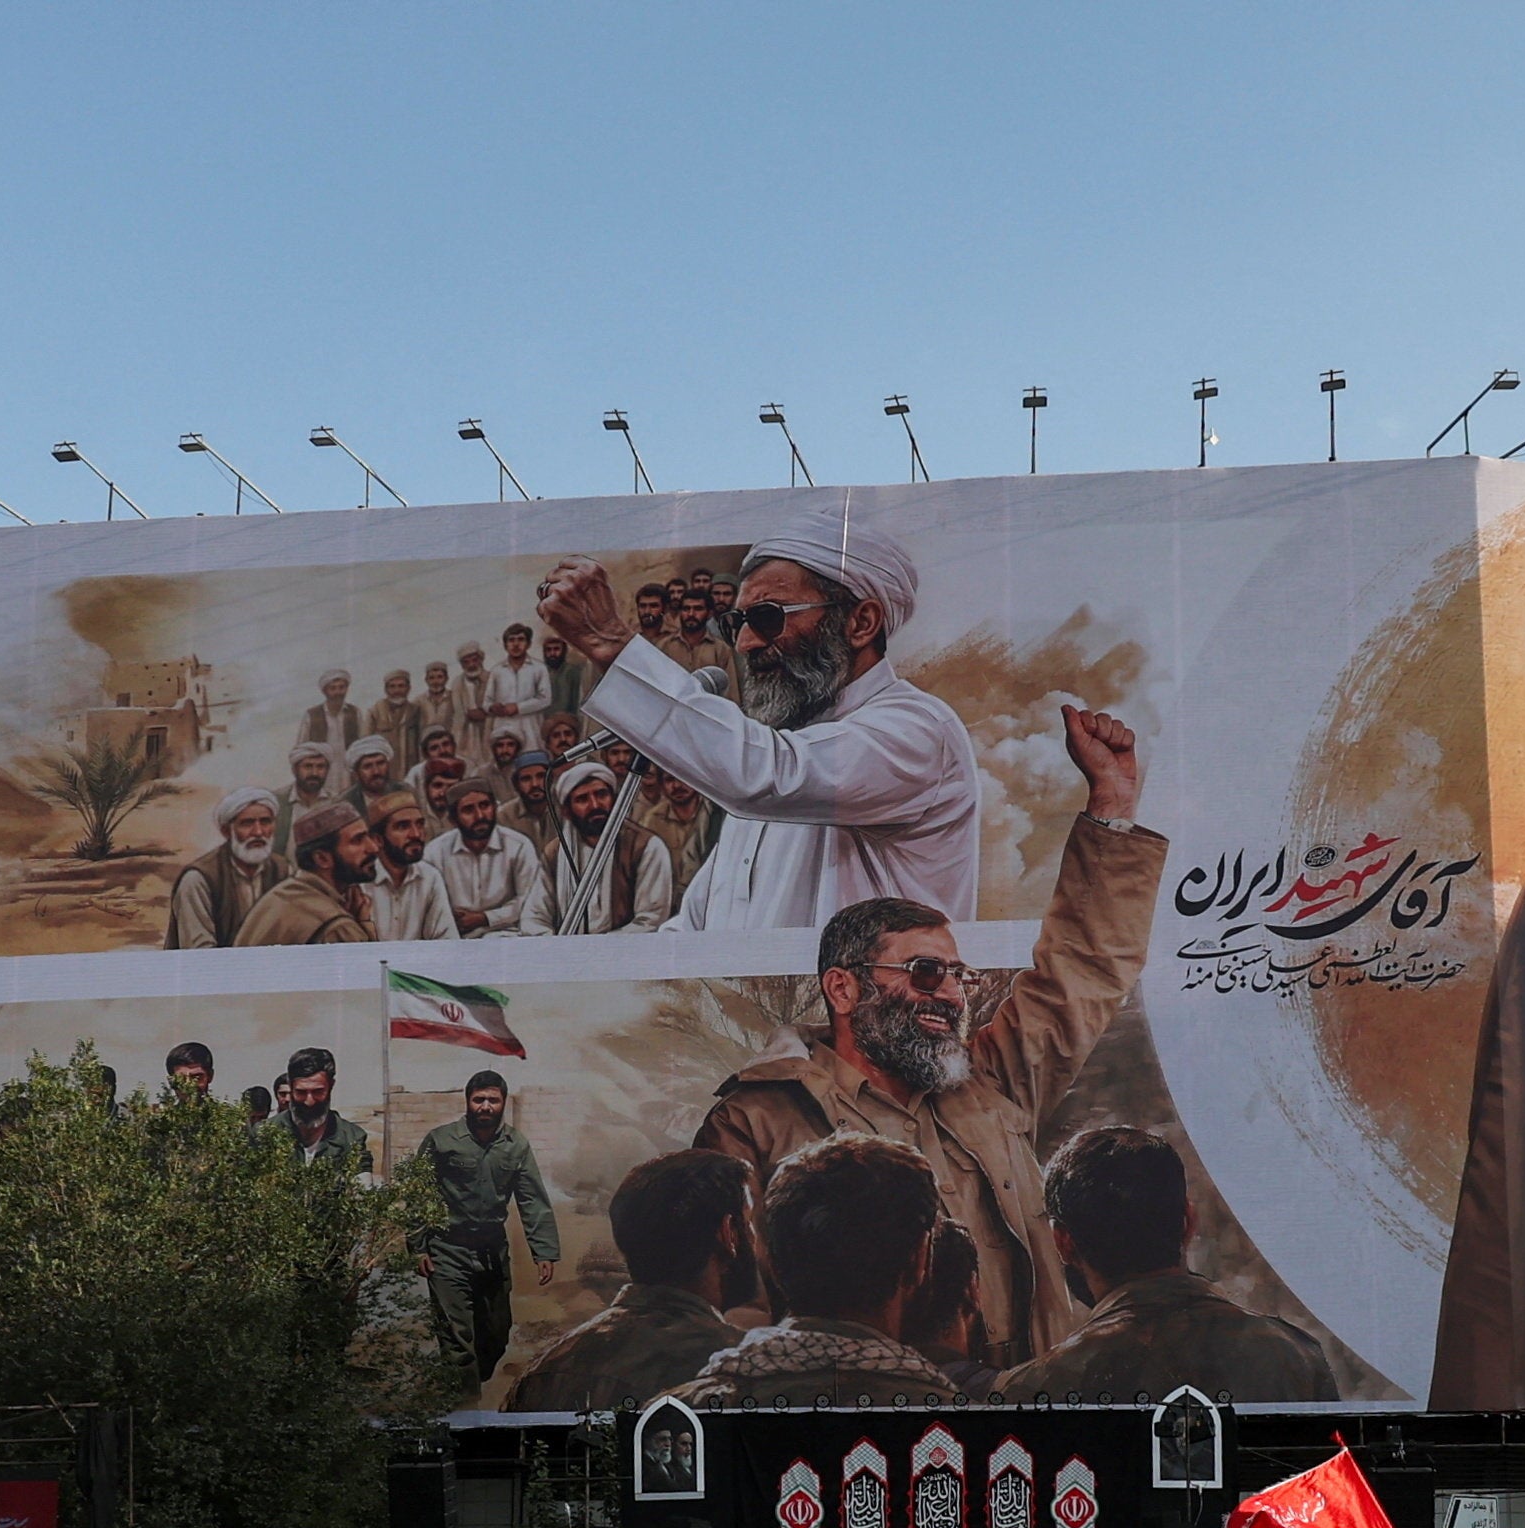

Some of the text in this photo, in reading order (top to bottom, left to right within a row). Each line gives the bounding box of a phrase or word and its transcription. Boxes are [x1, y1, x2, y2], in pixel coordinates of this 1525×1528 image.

[1174, 832, 1481, 940] آقای شهید ایران
